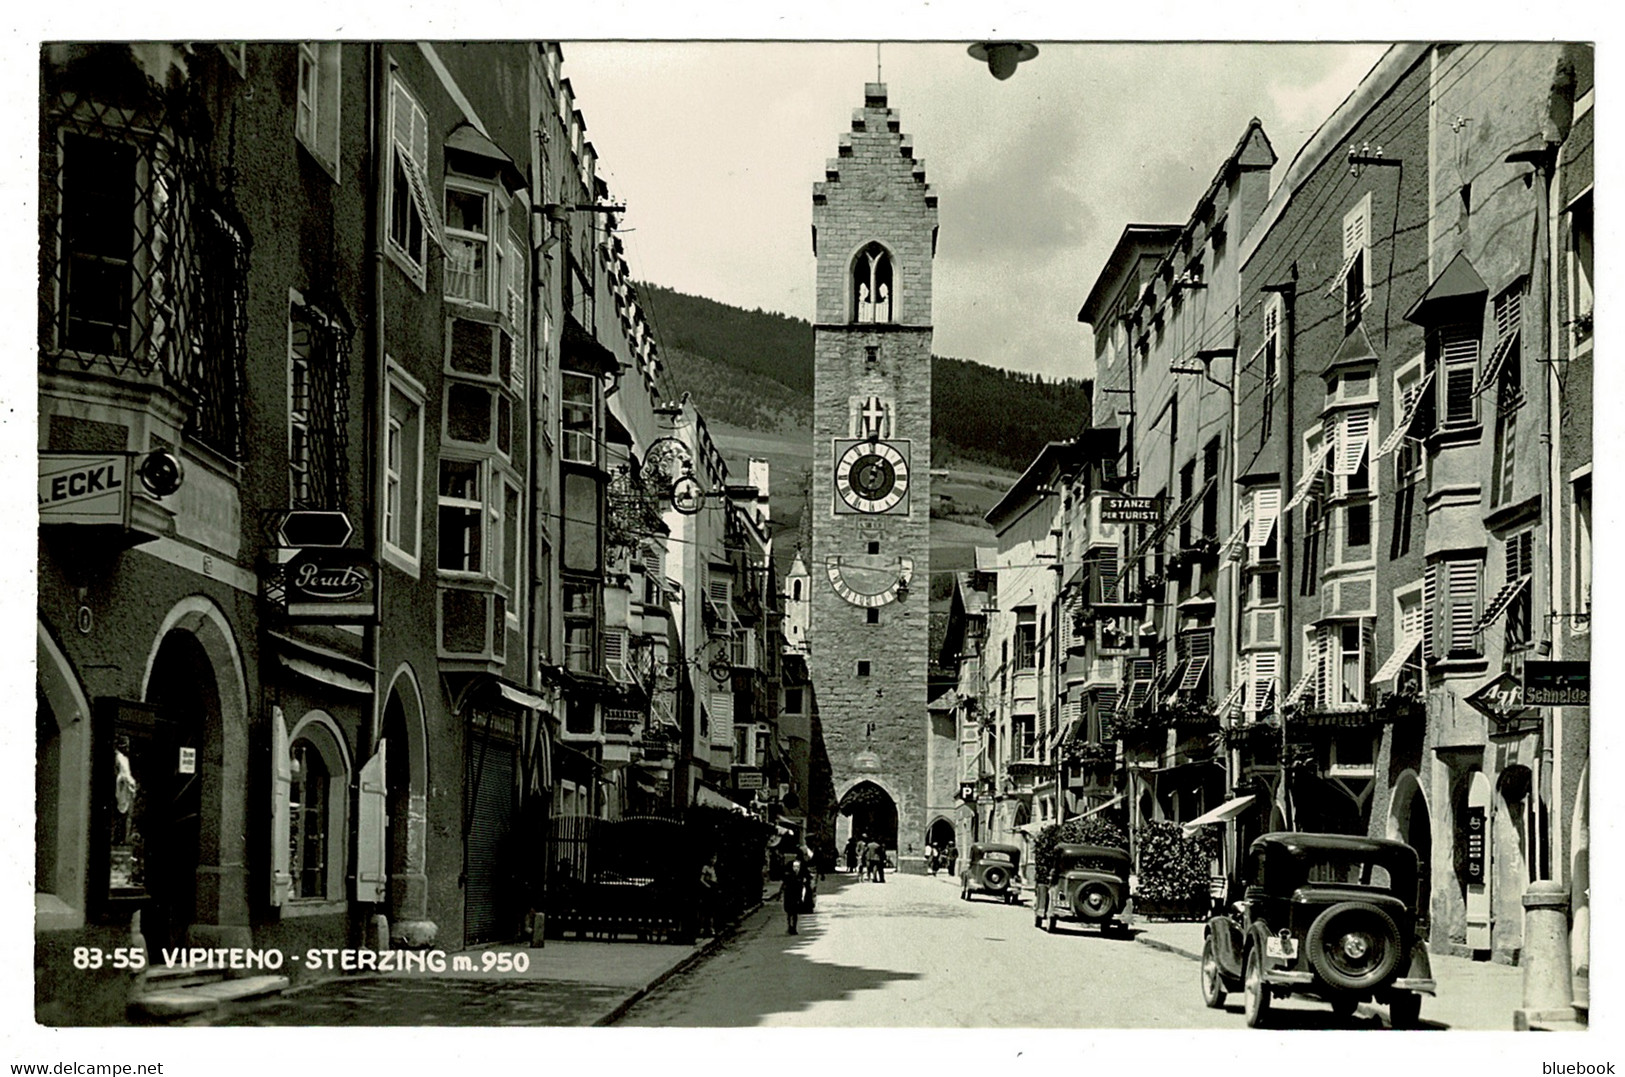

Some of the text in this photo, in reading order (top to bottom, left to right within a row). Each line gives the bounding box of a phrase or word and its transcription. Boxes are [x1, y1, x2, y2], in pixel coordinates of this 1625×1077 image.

[1110, 499, 1151, 509] STANZE
[1102, 510, 1159, 520] PER TURISTI
[295, 563, 363, 593] Perutz
[1525, 686, 1590, 704] Schneide
[962, 787, 973, 799] P
